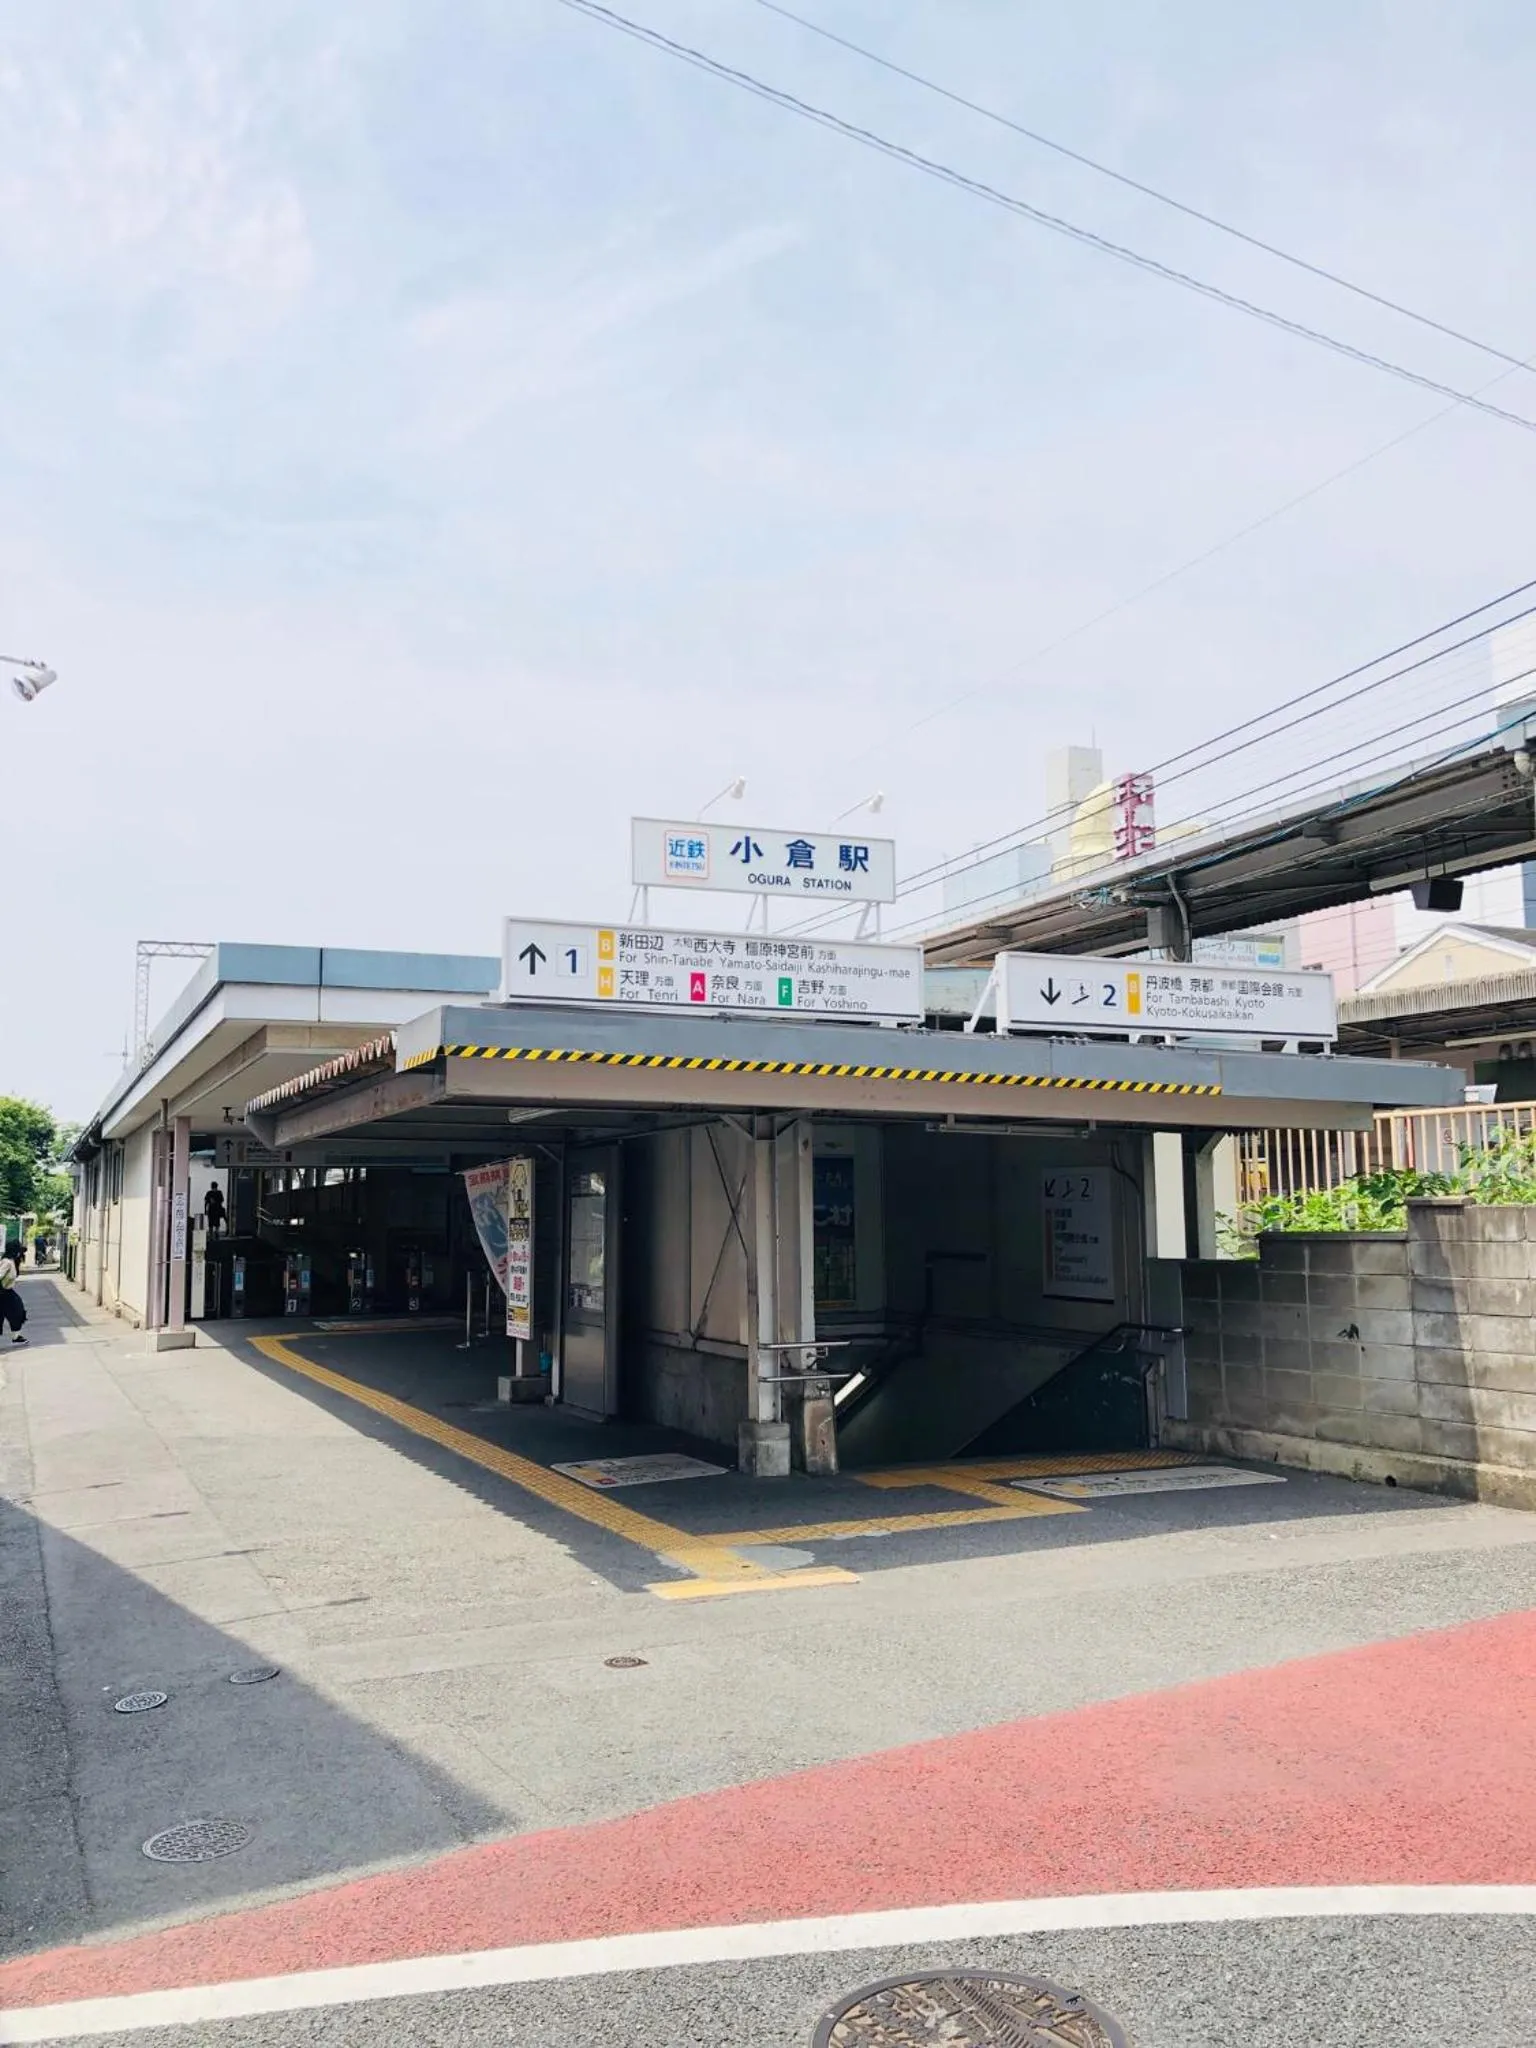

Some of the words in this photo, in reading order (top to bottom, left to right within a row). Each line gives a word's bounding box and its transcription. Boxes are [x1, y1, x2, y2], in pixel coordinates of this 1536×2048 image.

[669, 838, 705, 859] 近鉄
[729, 835, 870, 873] 小倉駅
[748, 872, 791, 887] OGURA
[802, 877, 852, 891] STATION
[619, 933, 664, 951] 新田辺
[745, 941, 814, 960] 橿原神宮前
[565, 948, 577, 974] 1
[619, 951, 637, 963] For
[644, 952, 713, 968] Shin-Tanabe
[720, 957, 803, 974] Yamato-Saidaiji
[808, 964, 911, 979] Kashiharajingu-mae
[601, 975, 611, 989] H
[620, 970, 650, 986] 天理
[655, 975, 674, 987] 方面
[692, 980, 704, 994] A
[711, 974, 740, 990] 奈良
[781, 984, 790, 998] F
[798, 979, 824, 994] 吉野
[829, 985, 848, 996] 方面
[1146, 975, 1183, 991] 丹波橋
[1190, 978, 1214, 993] 京都
[620, 987, 640, 999] For
[648, 988, 679, 1001] Tenri
[711, 991, 731, 1004] For
[737, 992, 766, 1006] Nara
[797, 996, 816, 1008] For
[824, 997, 868, 1011] Yoshino
[1102, 983, 1117, 1007] 2
[1146, 992, 1162, 1003] For
[1169, 993, 1229, 1006] Tambabashi
[1235, 996, 1266, 1010] Kyoto
[1146, 1004, 1254, 1020] Kyoto-Kokusaikaikan
[1080, 1177, 1090, 1198] 2
